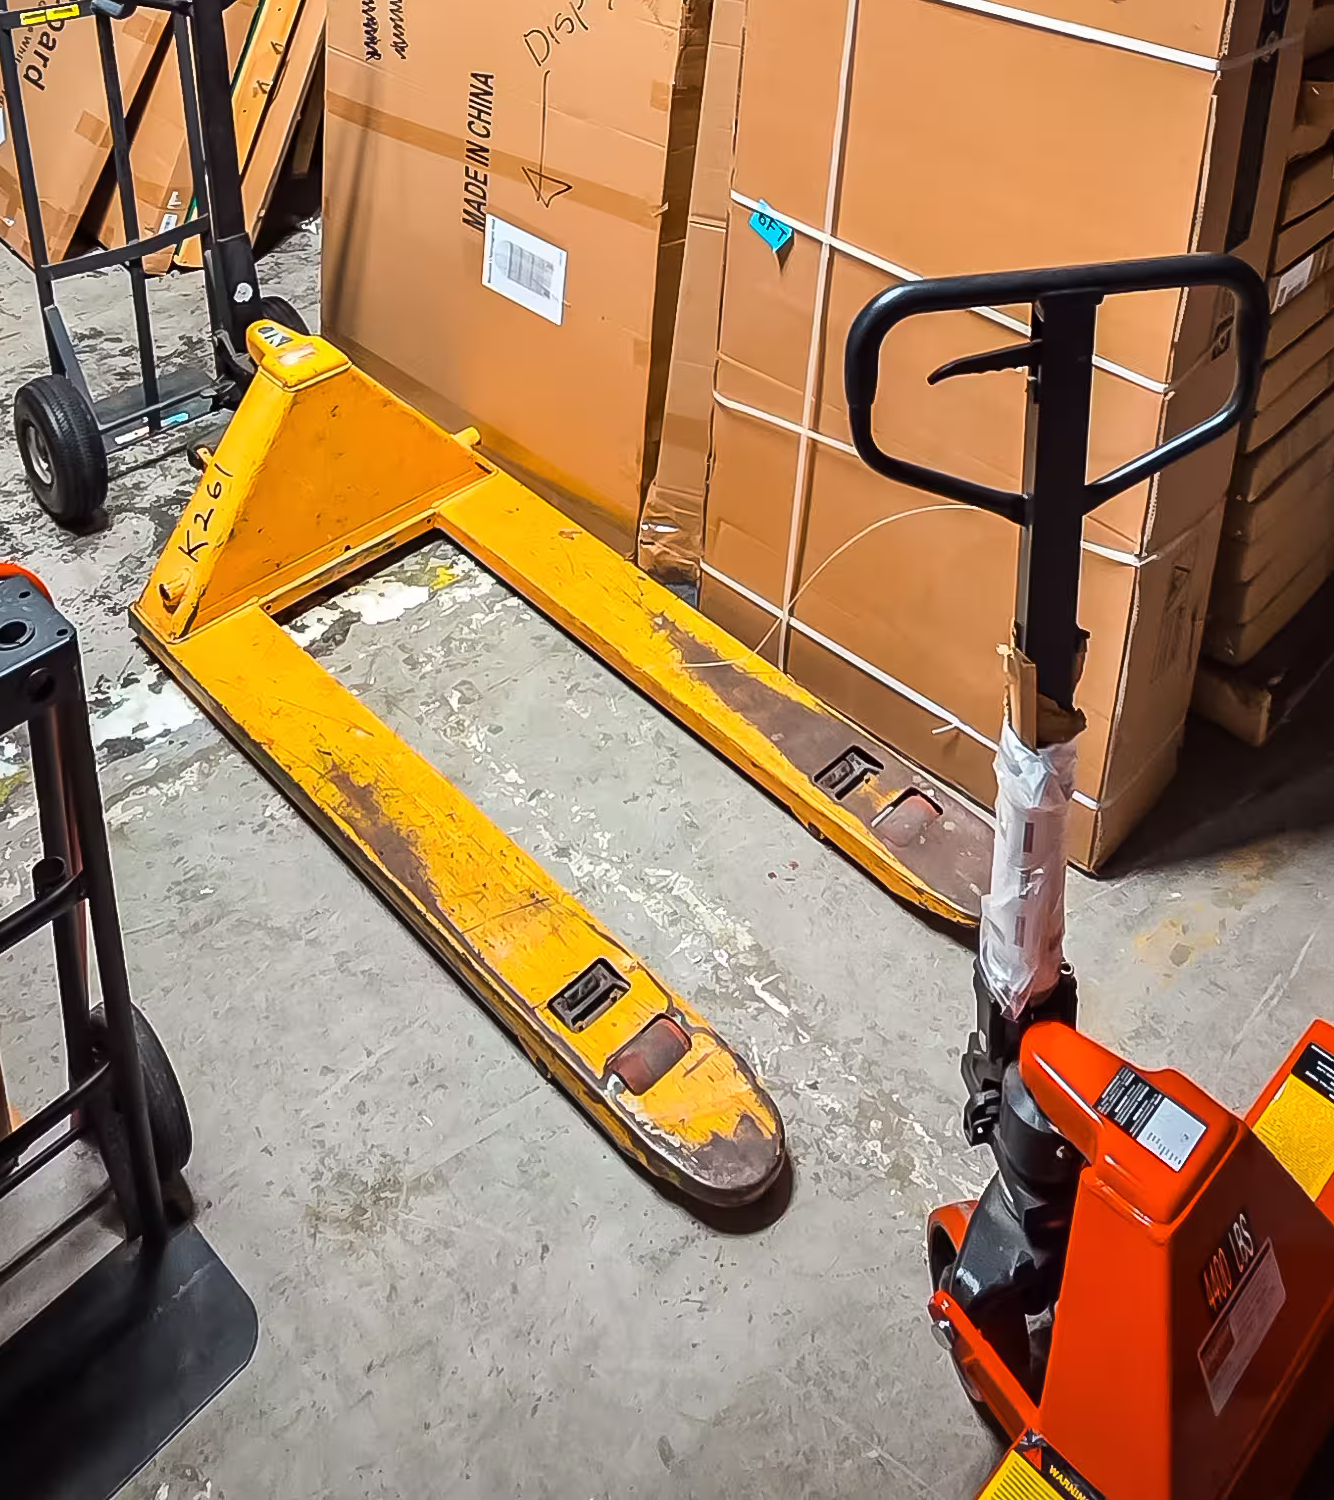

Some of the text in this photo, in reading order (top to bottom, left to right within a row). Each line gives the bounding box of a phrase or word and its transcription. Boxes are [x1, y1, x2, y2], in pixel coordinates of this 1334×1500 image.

[462, 71, 495, 232] MADE IN CHINA
[1204, 1213, 1254, 1312] 4400 LBS
[1049, 1464, 1090, 1500] WARNIN
